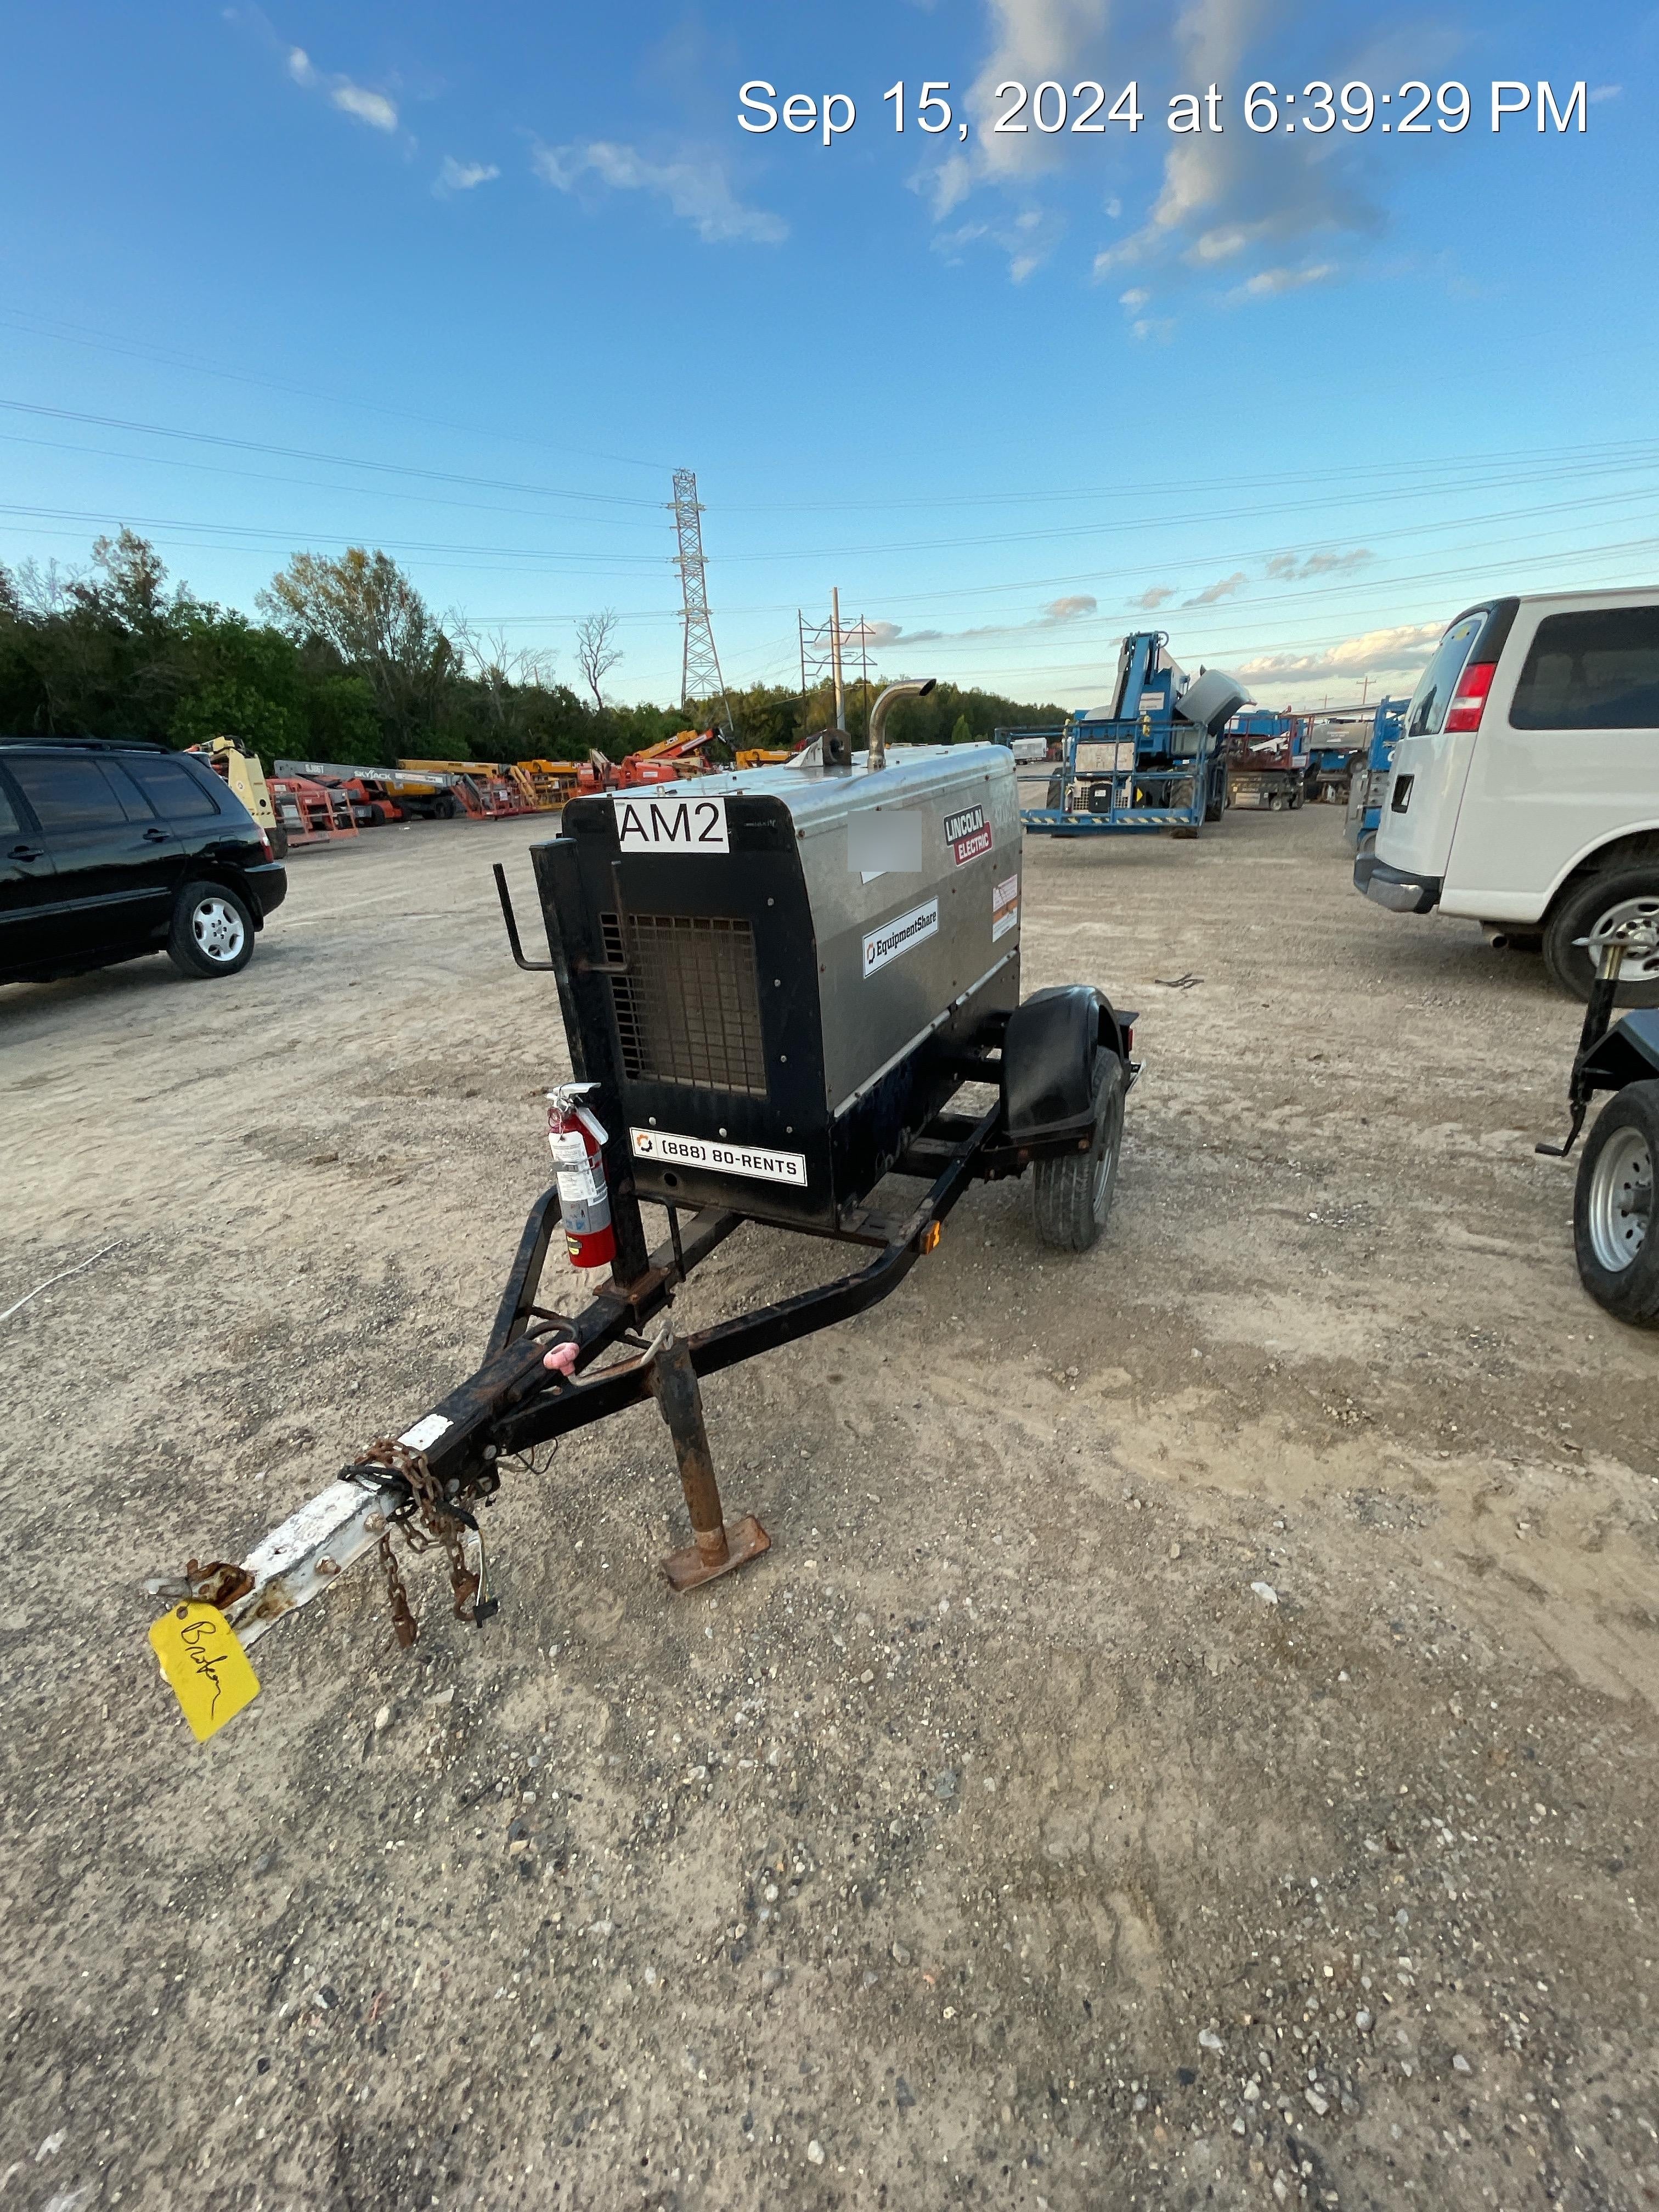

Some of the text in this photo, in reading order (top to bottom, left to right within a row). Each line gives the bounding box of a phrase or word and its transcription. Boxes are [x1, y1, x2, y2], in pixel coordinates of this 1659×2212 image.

[354, 769, 392, 780] SKYJACK
[620, 802, 724, 842] AM2
[945, 809, 984, 842] LINCOLN
[958, 832, 990, 860] ELECTRIC
[876, 911, 937, 956] EquipmentShare
[662, 1140, 797, 1175] (888) 80-RENTS
